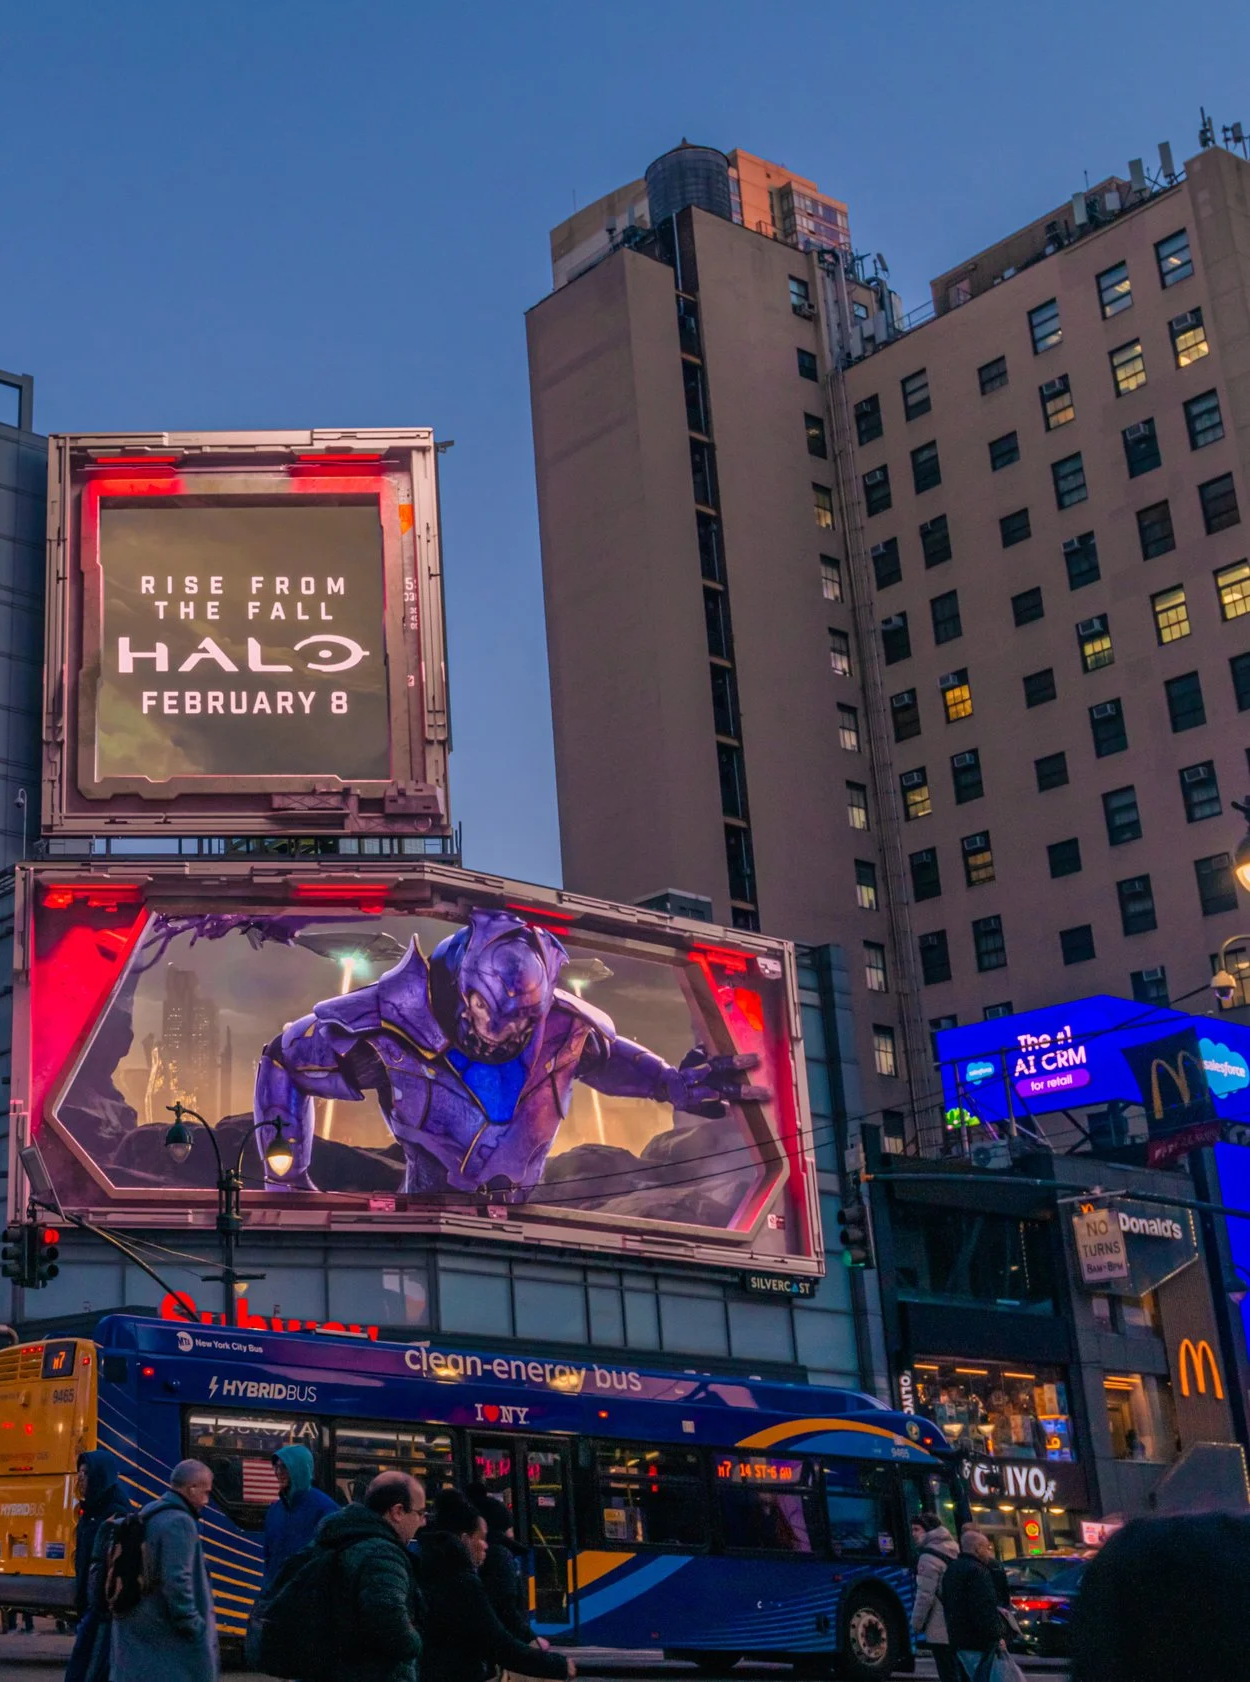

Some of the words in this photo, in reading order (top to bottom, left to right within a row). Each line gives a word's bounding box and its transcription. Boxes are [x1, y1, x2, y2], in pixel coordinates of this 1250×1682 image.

[141, 576, 223, 595] RISE
[251, 576, 345, 595] FROM
[154, 601, 220, 620] THE
[248, 602, 333, 620] FALL
[118, 634, 370, 673] HALO
[142, 691, 316, 714] FEBRUARY
[330, 691, 348, 714] 8
[1017, 1034, 1051, 1053] The
[1057, 1025, 1073, 1045] #1
[1014, 1055, 1037, 1077] AI
[1041, 1045, 1087, 1071] CRM
[1204, 1059, 1246, 1078] salesforce
[1030, 1080, 1044, 1091] for
[1047, 1074, 1073, 1088] retail
[1086, 1219, 1109, 1237] NO
[1082, 1241, 1121, 1257] TURNS
[195, 1338, 212, 1348] New
[213, 1340, 231, 1350] York
[231, 1342, 247, 1353] City
[248, 1344, 264, 1354] Bus
[404, 1345, 586, 1394] clean-energy
[593, 1363, 643, 1392] bus
[53, 1388, 75, 1404] 9465
[475, 1403, 484, 1421] I
[499, 1404, 530, 1425] NY
[739, 1465, 751, 1478] 14
